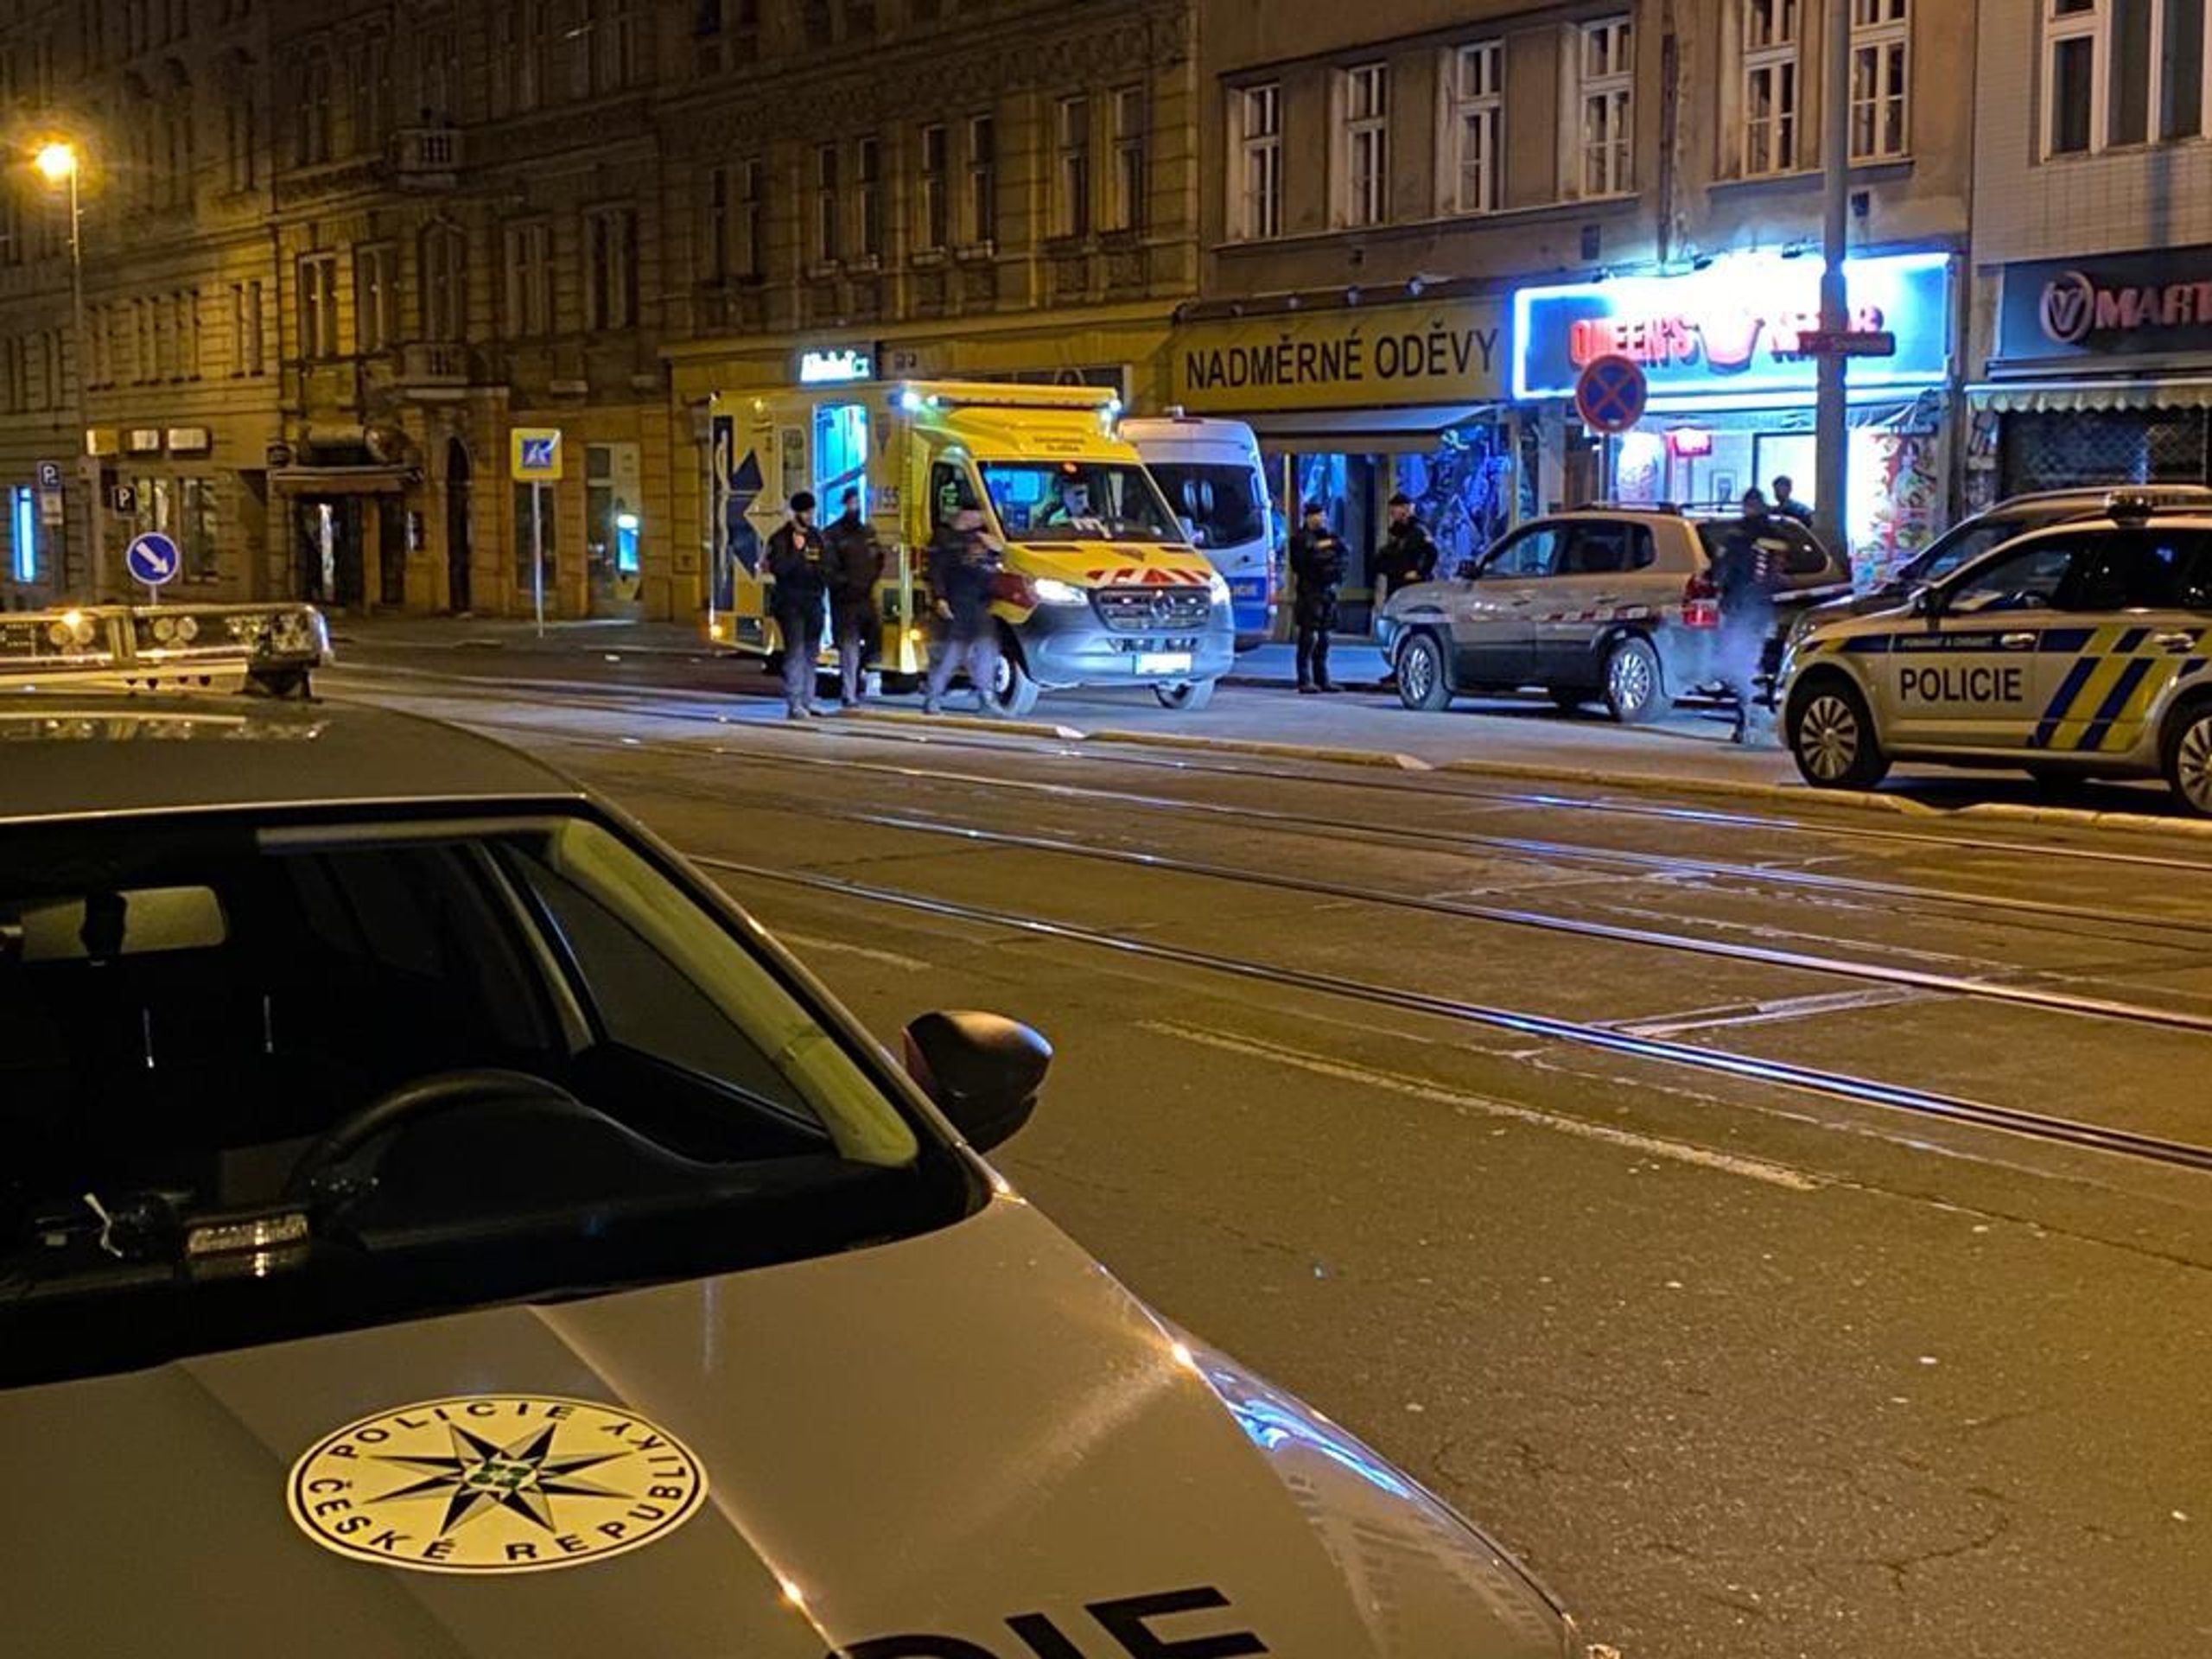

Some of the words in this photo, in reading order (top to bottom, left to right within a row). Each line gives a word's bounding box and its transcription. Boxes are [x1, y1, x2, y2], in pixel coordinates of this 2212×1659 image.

[1186, 328, 1363, 391] NADMĚRNÉ
[1374, 321, 1499, 380] ODĚVY
[1900, 667, 2024, 702] POLICIE
[327, 1402, 575, 1460] POLICIE
[308, 1477, 457, 1561] ČESKÉ
[505, 1421, 687, 1561] REPUBLIKY
